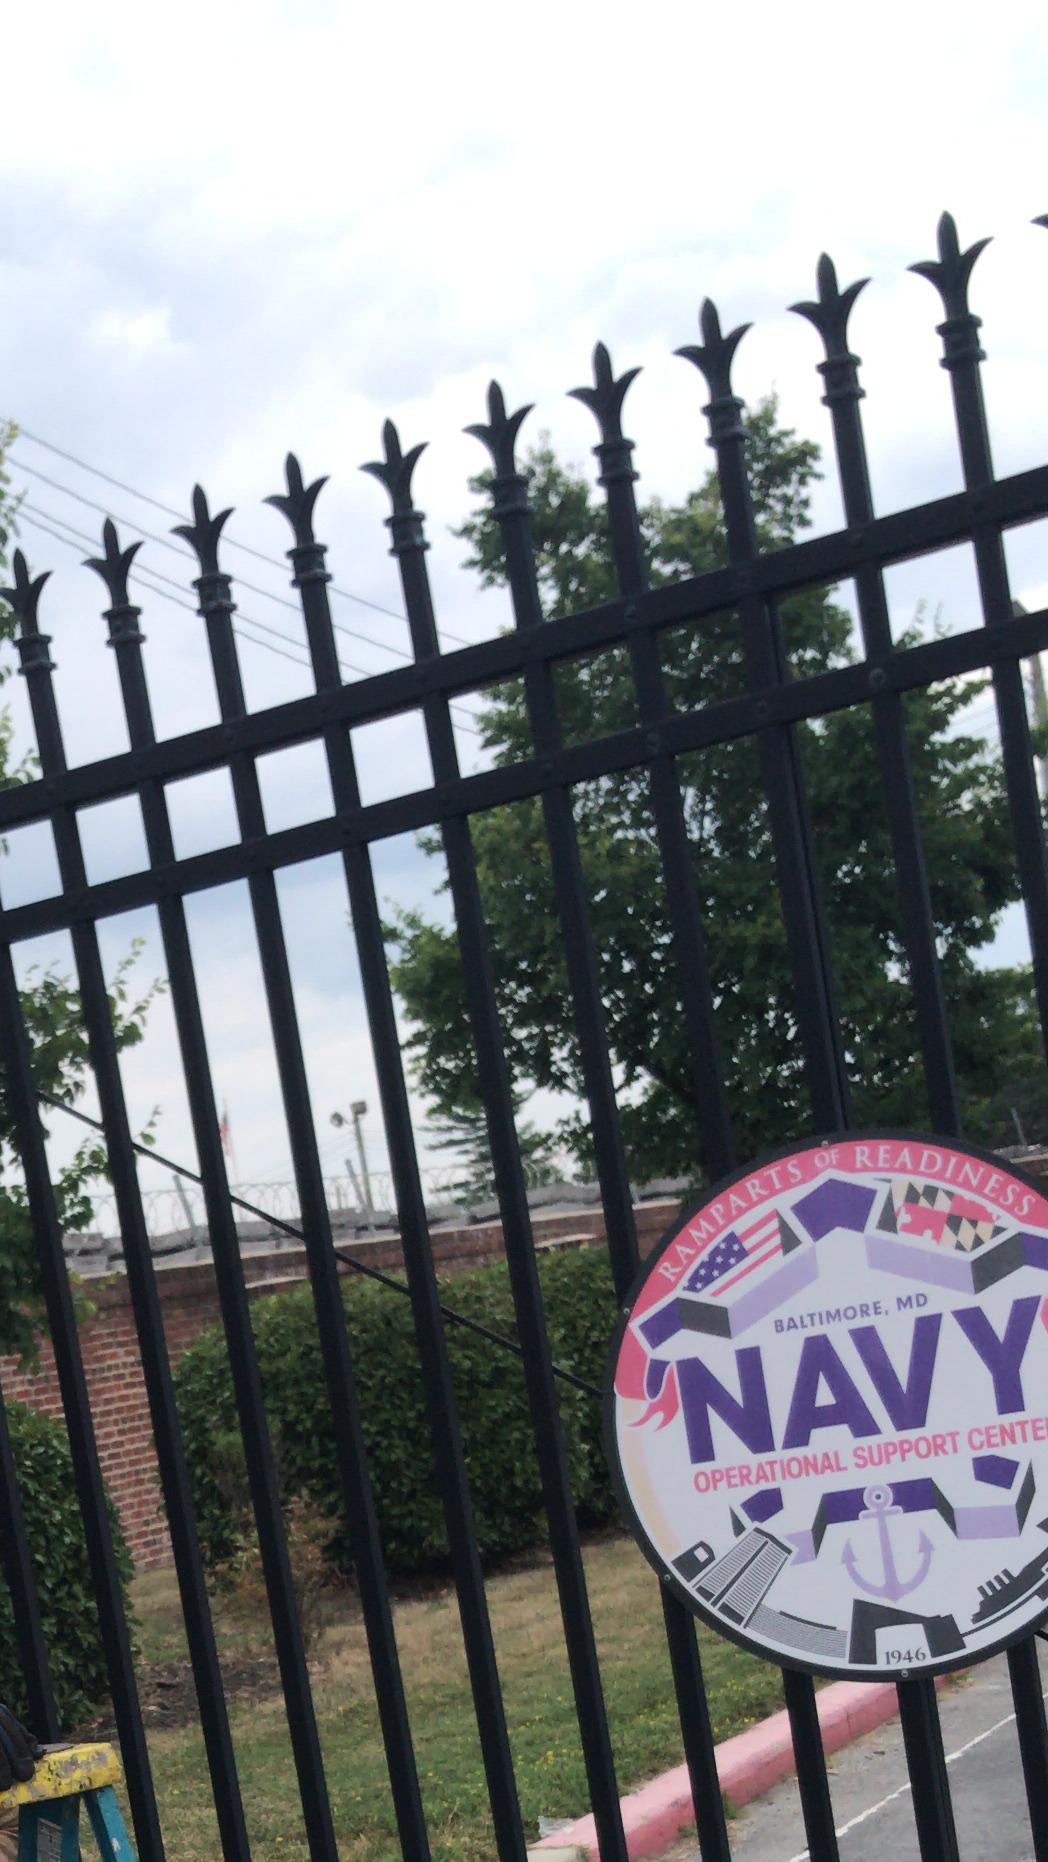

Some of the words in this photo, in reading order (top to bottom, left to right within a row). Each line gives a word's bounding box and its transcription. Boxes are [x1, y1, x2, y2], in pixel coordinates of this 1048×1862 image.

[658, 1159, 801, 1282] RAMPARTS
[814, 1148, 840, 1168] OF
[855, 1147, 1037, 1216] READINESS
[774, 1301, 889, 1333] BALTIMORE,
[895, 1293, 928, 1312] MD
[676, 1295, 1042, 1464] NAVY
[693, 1450, 848, 1494] OPERATIONAL
[853, 1432, 960, 1469] SUPPORT
[967, 1417, 1048, 1451] CENTE
[883, 1645, 927, 1666] 1946
